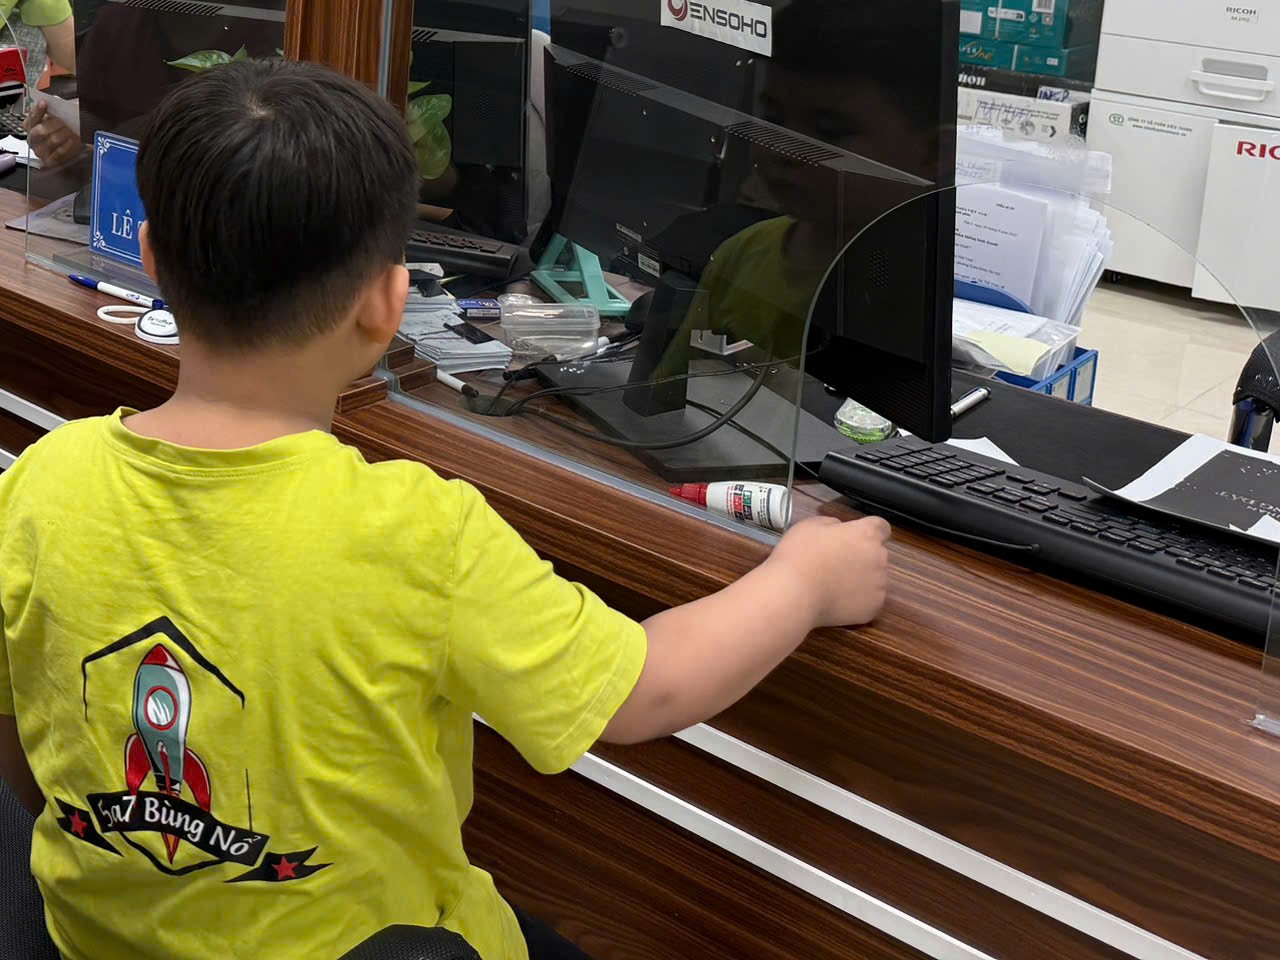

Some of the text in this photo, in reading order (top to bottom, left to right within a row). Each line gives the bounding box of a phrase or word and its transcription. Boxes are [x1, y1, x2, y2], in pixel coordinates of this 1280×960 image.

[689, 1, 767, 39] ENSOHO
[1226, 6, 1257, 16] RICOH
[111, 209, 134, 239] LÊ
[144, 797, 204, 843] Bùng
[209, 825, 261, 856] Nổ
